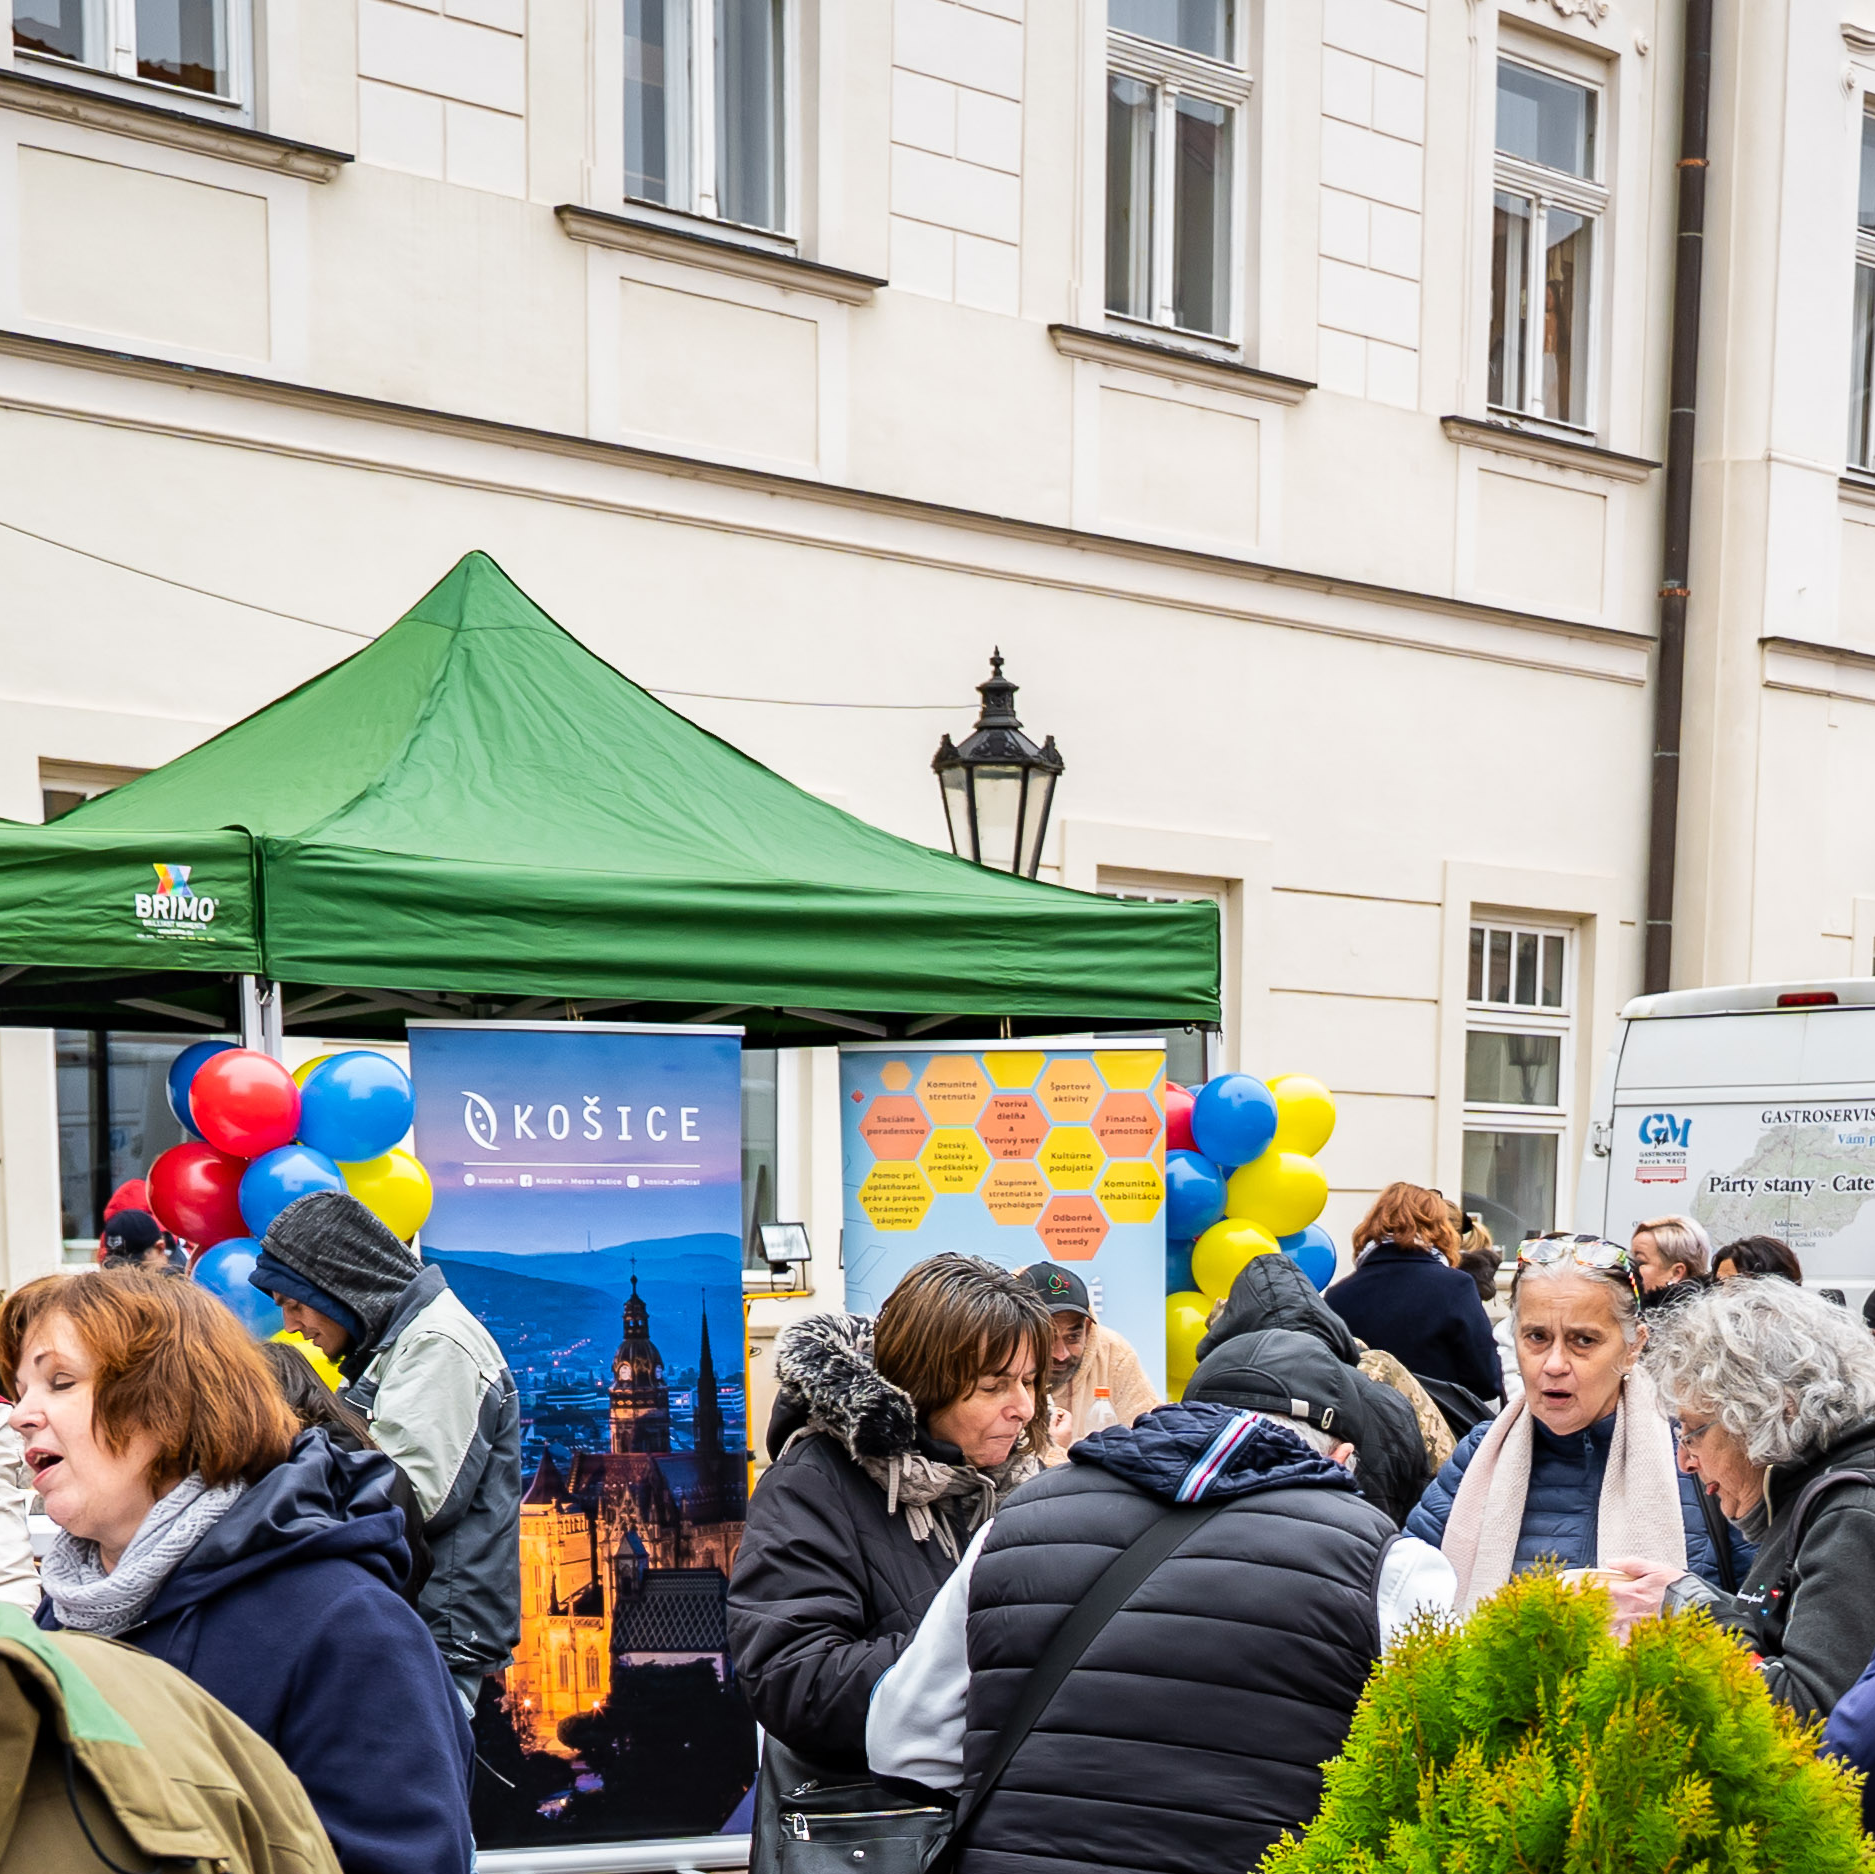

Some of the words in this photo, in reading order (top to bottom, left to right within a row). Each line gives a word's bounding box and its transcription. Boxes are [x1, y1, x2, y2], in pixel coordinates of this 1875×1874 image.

[134, 893, 216, 922] BRIMO
[926, 1080, 978, 1089] Komunitné
[1050, 1081, 1091, 1092] Športové
[928, 1092, 976, 1101] stretnutia
[1053, 1095, 1089, 1104] aktivity
[994, 1100, 1028, 1108] Tvorivá
[513, 1095, 701, 1142] KOŠICE
[876, 1115, 915, 1123] Sociálne
[1105, 1115, 1147, 1123] Finančná
[866, 1127, 925, 1136] poradenstvo
[983, 1136, 1017, 1145] Tvorivý
[1020, 1136, 1039, 1144] svet
[1837, 1132, 1865, 1144] Vám
[1051, 1152, 1092, 1160] Kultúrne
[1049, 1164, 1094, 1174] podujatia
[994, 1179, 1038, 1188] Skupinové
[1104, 1180, 1157, 1188] Komunitná
[1708, 1174, 1758, 1197] Párty
[1763, 1178, 1815, 1197] stany
[862, 1194, 883, 1203] práv
[892, 1194, 926, 1203] právom
[988, 1190, 1032, 1198] stretnutia
[1052, 1214, 1093, 1222] Odborné
[1056, 1238, 1089, 1247] besedy
